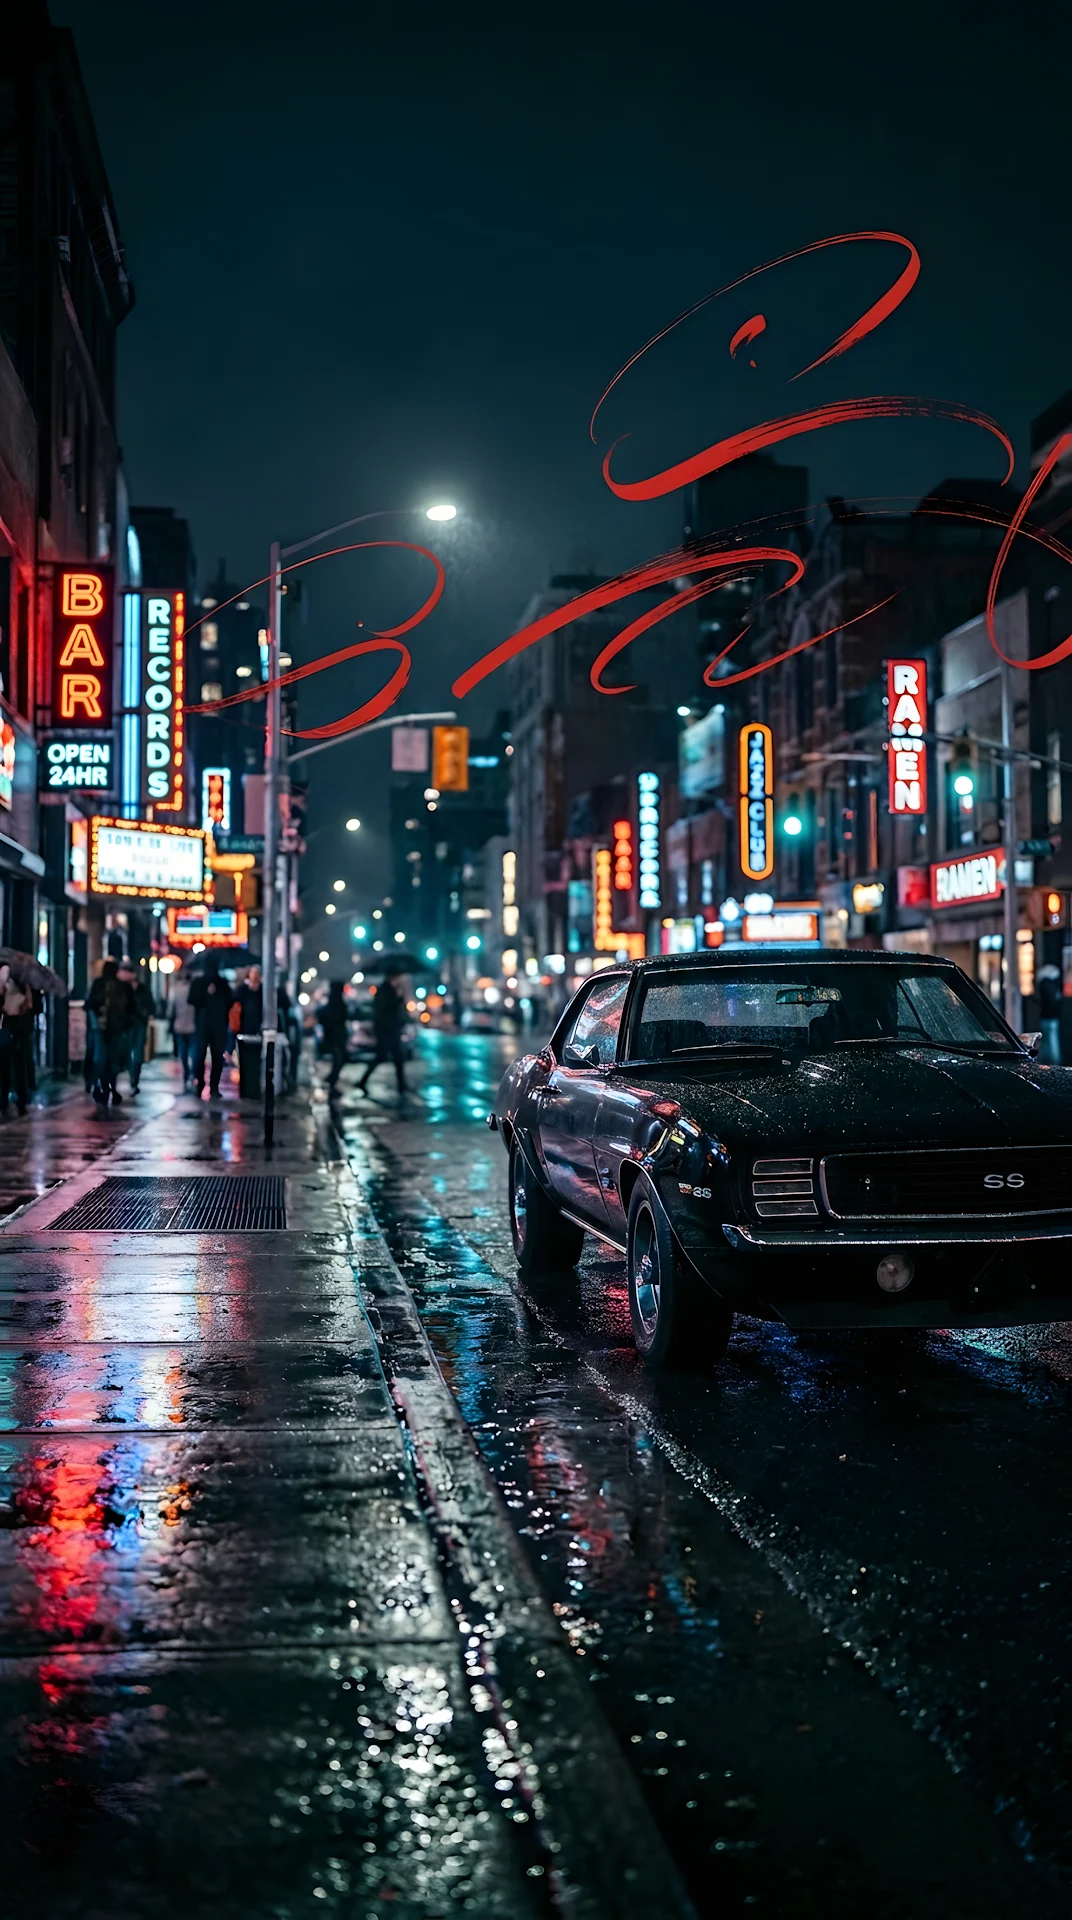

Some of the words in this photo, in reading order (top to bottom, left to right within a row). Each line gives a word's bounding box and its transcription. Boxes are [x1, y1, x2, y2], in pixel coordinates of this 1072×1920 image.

[60, 573, 104, 719] BAR
[145, 598, 172, 798] RECORDS
[47, 743, 110, 764] OPEN
[891, 665, 924, 810] RAMEN
[48, 765, 108, 786] 24HR
[936, 855, 997, 902] RAMEN
[984, 1173, 1025, 1188] SS
